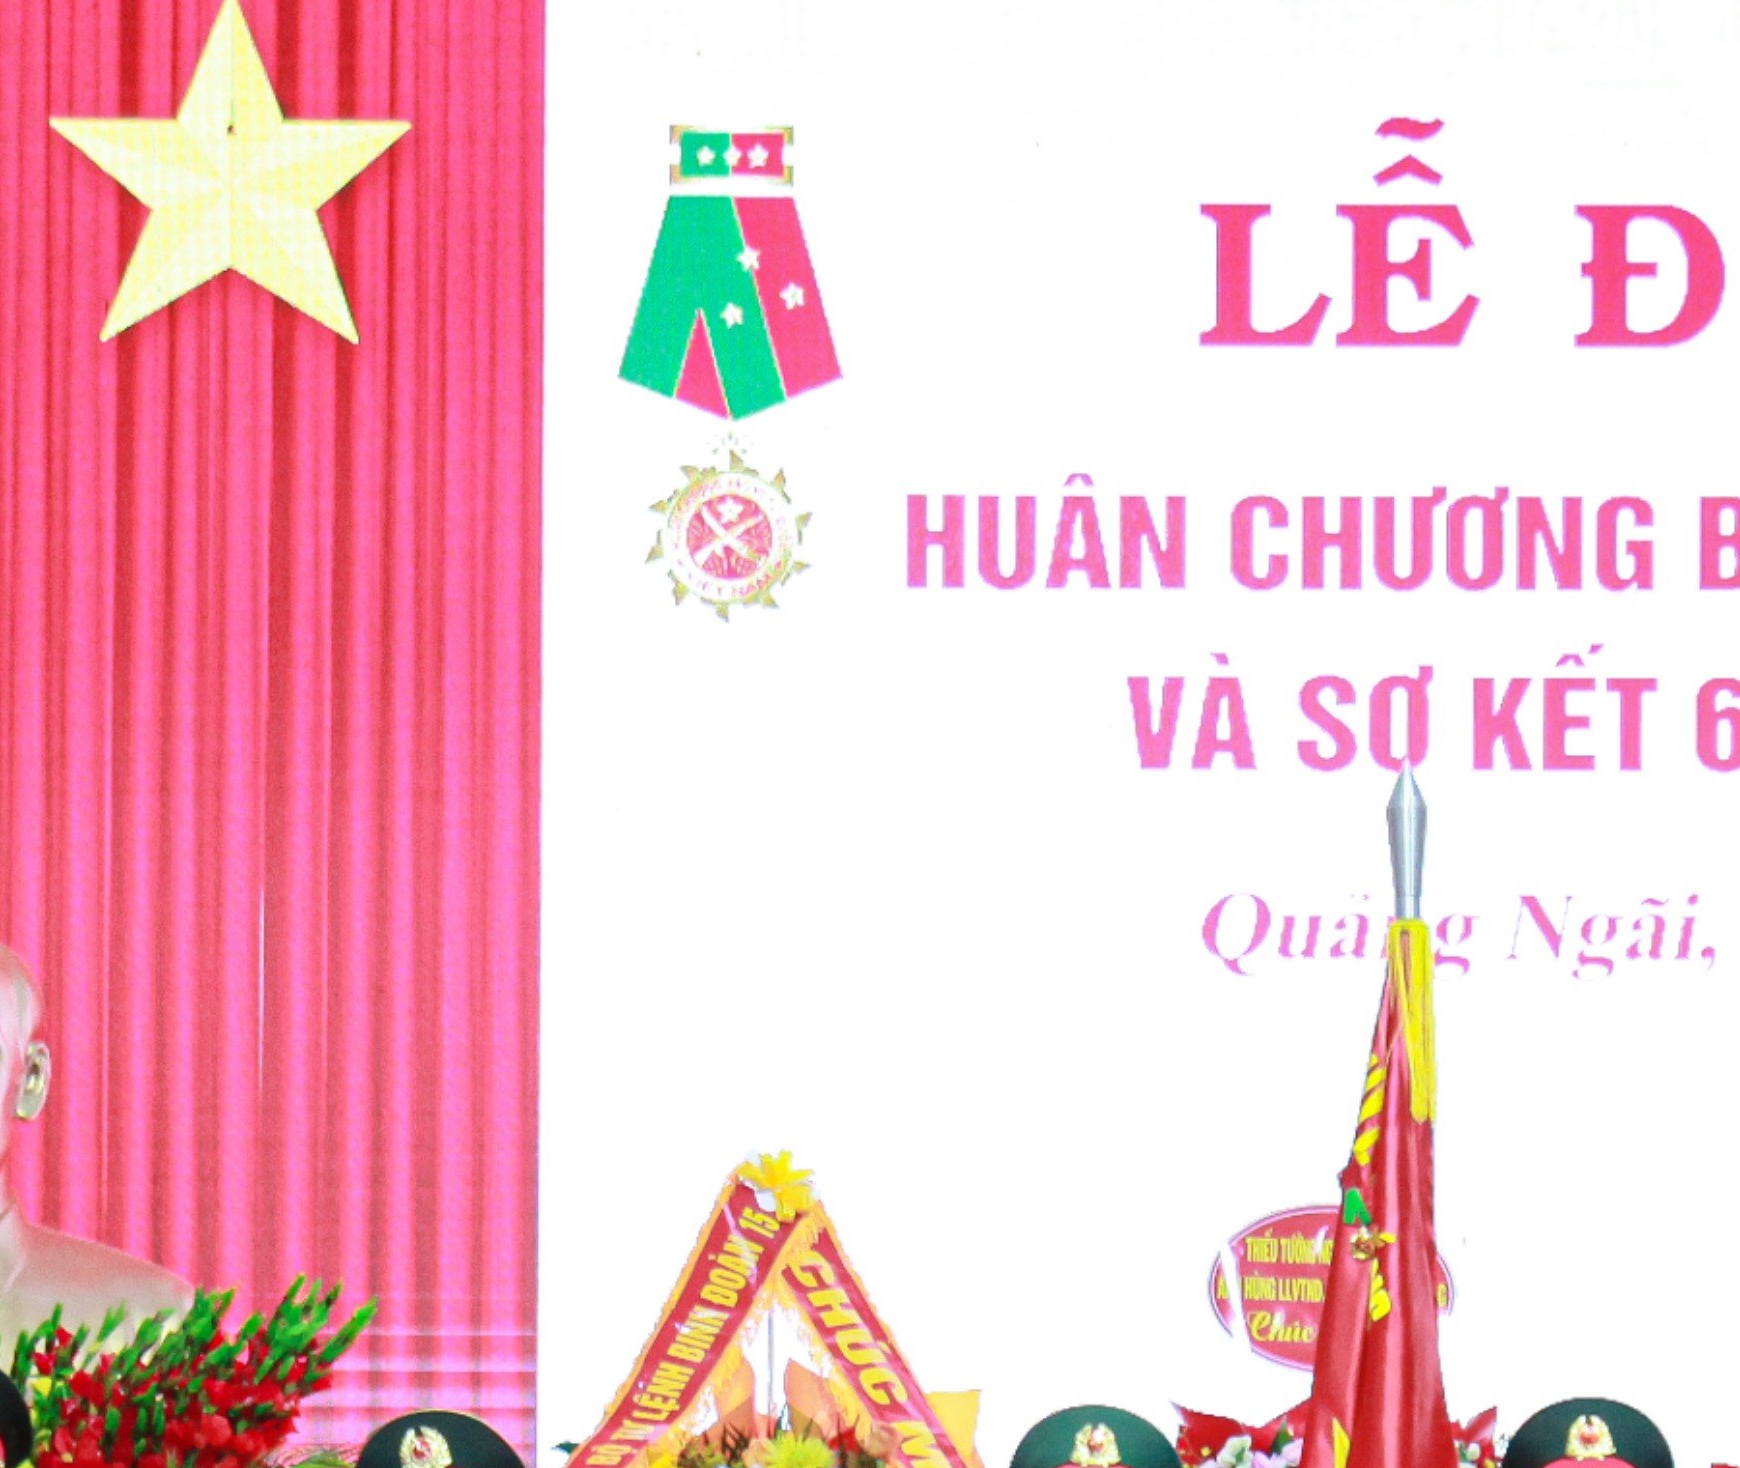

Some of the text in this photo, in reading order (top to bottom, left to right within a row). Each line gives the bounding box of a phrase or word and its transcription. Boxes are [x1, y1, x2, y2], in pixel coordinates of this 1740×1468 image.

[1200, 117, 1480, 347] LỄ
[907, 473, 1186, 590] HUÂN
[1231, 487, 1653, 591] CHƯƠNG
[1127, 653, 1256, 769] VÀ
[1298, 666, 1433, 772] SƠ
[1473, 644, 1657, 770] KẾT
[1202, 892, 1480, 981] Quảg
[1510, 895, 1717, 980] Ngãi,
[632, 1362, 695, 1421] LỆNH
[667, 1305, 730, 1363] BINH
[700, 1234, 765, 1307] ĐOÀN
[739, 1206, 780, 1238] 15
[788, 1250, 908, 1405] CHÚC
